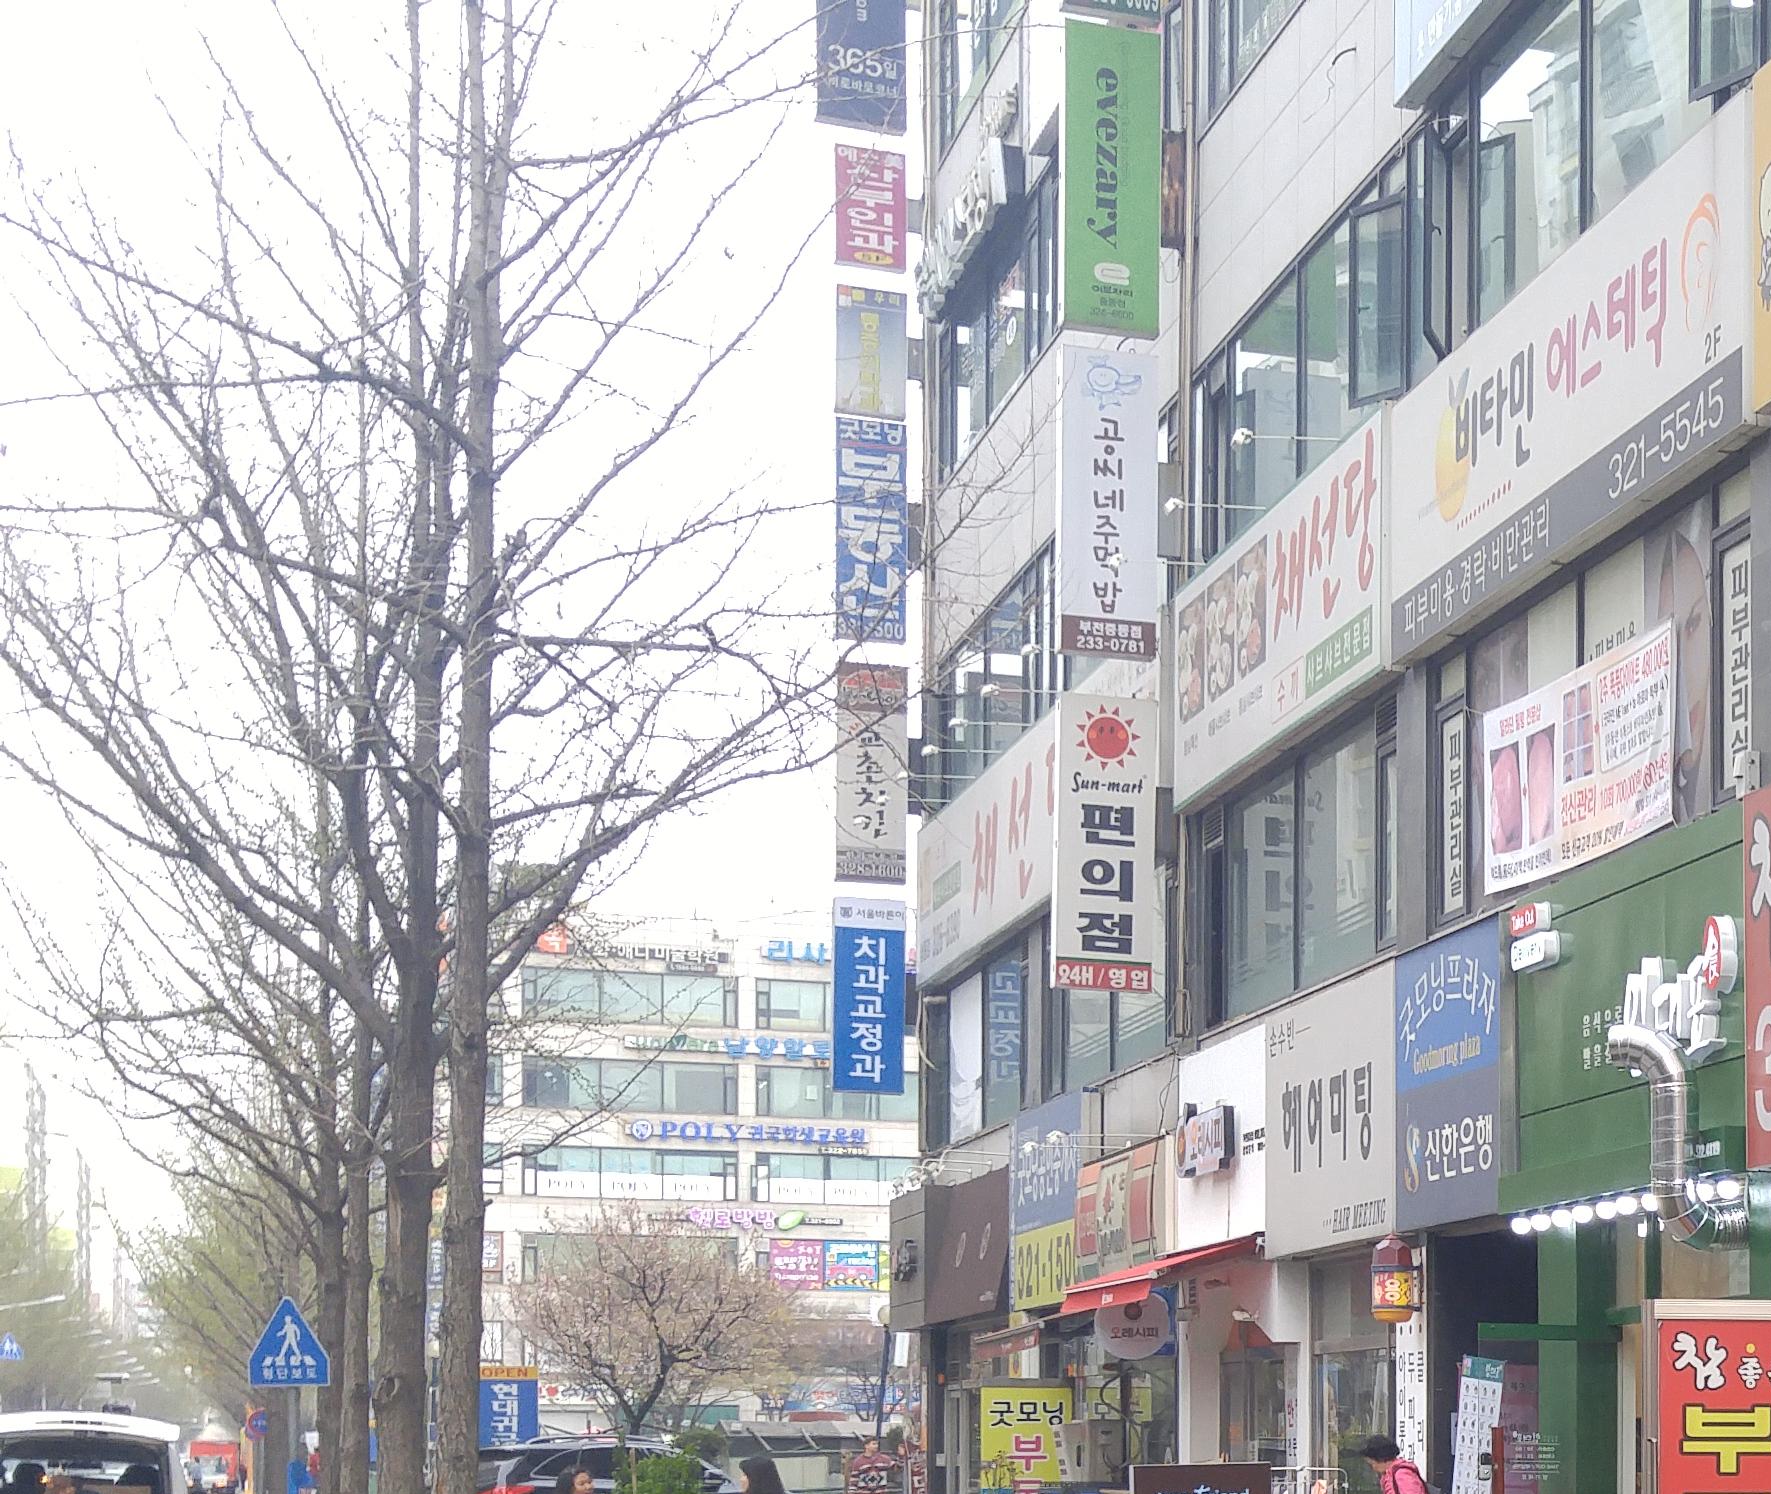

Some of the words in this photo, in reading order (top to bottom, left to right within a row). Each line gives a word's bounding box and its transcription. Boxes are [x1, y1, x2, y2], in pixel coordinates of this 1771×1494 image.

[1087, 67, 1118, 250] evezary
[1546, 237, 1668, 400] 에스테틱
[1705, 324, 1723, 365] 2F
[1455, 342, 1536, 470] 비타민
[1607, 377, 1724, 500] 321-5545
[1272, 428, 1378, 642] 채선당
[1076, 636, 1146, 654] 233-0781
[1071, 772, 1144, 796] Sun-mart
[1448, 733, 1462, 900] 피부관리실
[972, 743, 1056, 916] 채선
[1076, 804, 1136, 955] 편의점
[849, 936, 889, 1083] 치과교정과
[1058, 965, 1094, 986] 24H
[1108, 967, 1150, 991] 영업
[1399, 953, 1496, 1062] 굿모닝프라자
[1270, 1018, 1295, 1057] 손수빈
[1460, 1032, 1482, 1065] plaza
[661, 1121, 745, 1143] POLY
[1282, 1062, 1373, 1173] 헤어미팅
[1425, 1115, 1493, 1182] 신한은행
[1332, 1206, 1350, 1234] HAIR
[1352, 1198, 1386, 1231] MEETING
[1110, 1325, 1159, 1340] 오레시피
[1672, 1331, 1727, 1392] 참
[990, 1400, 1064, 1428] 굿모닝
